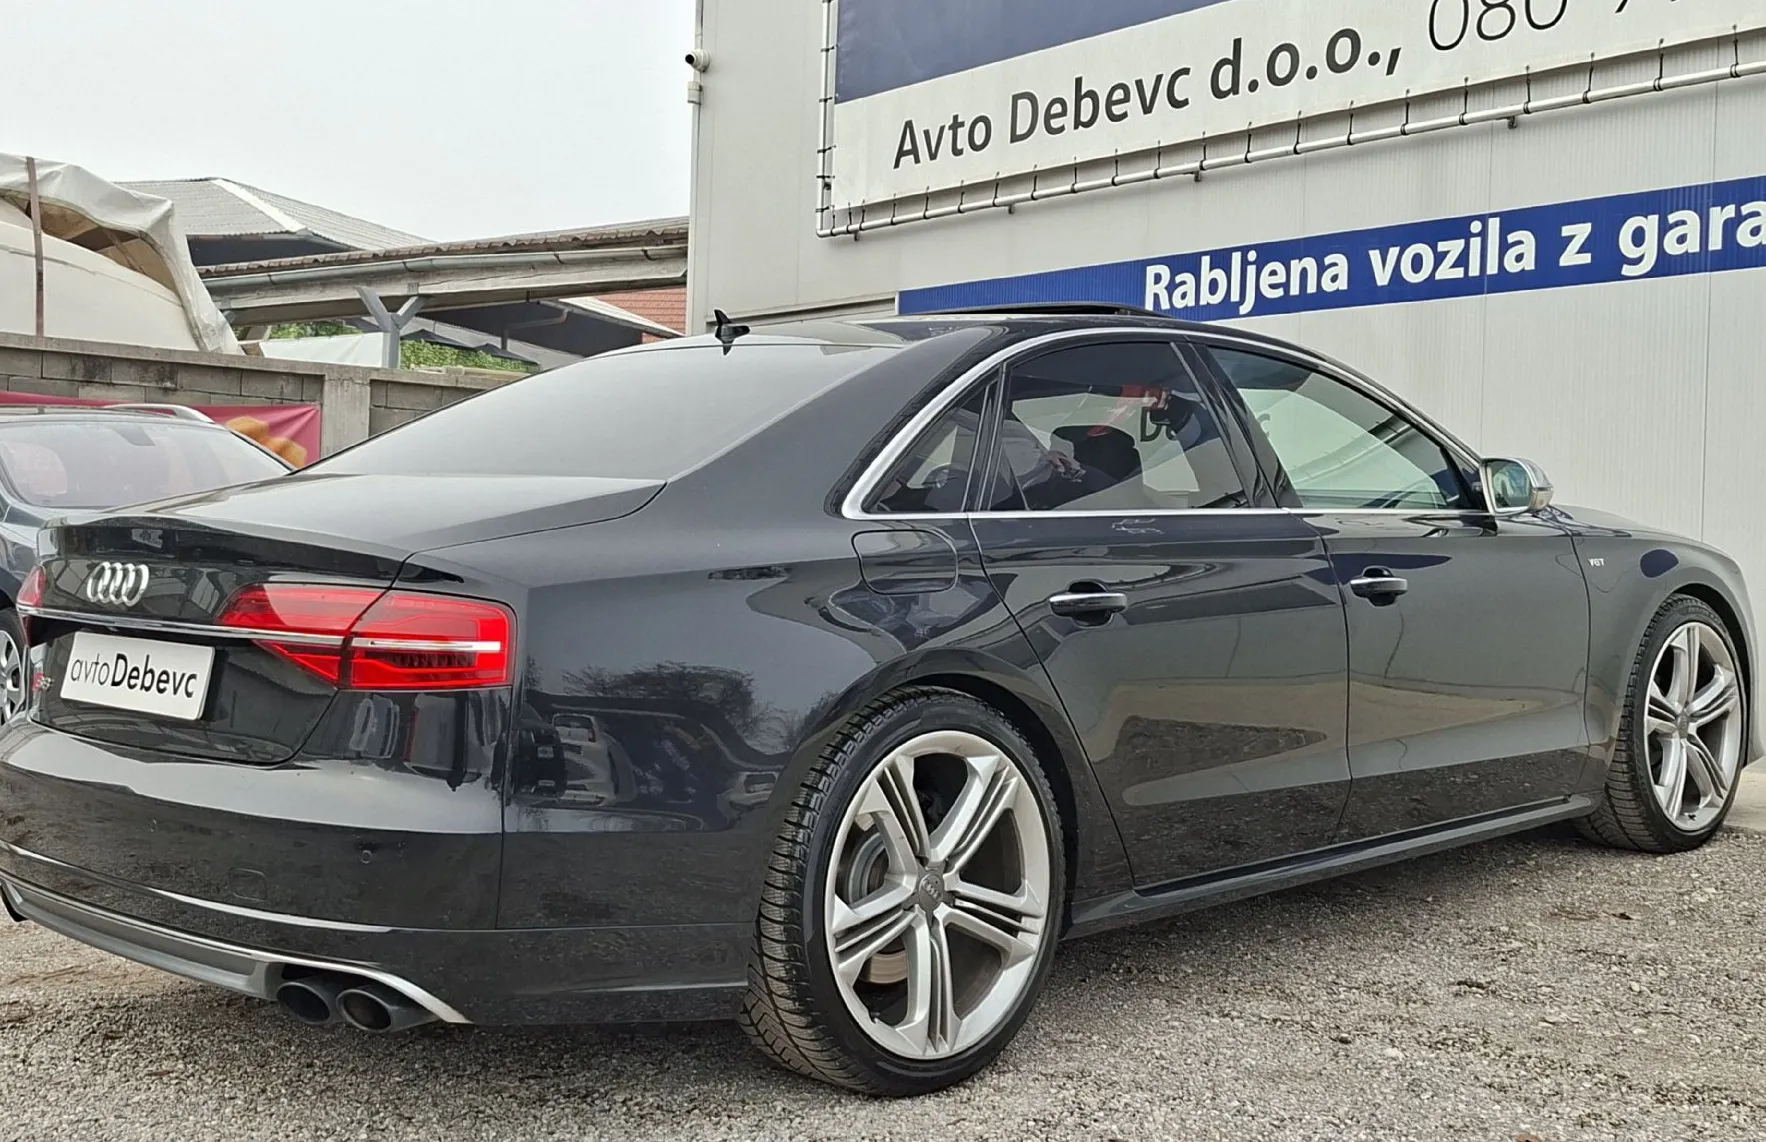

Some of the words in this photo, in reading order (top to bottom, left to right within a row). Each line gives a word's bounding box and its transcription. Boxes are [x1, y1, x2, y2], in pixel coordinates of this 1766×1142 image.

[893, 113, 992, 169] Avto
[1009, 66, 1191, 145] Debevc
[1210, 27, 1401, 100] d.o.o.,
[1145, 250, 1348, 315] Rabljena
[1368, 217, 1536, 287] vozila
[1559, 222, 1592, 267] z
[1618, 200, 1766, 277] gara
[70, 653, 198, 698] avtoDebevc
